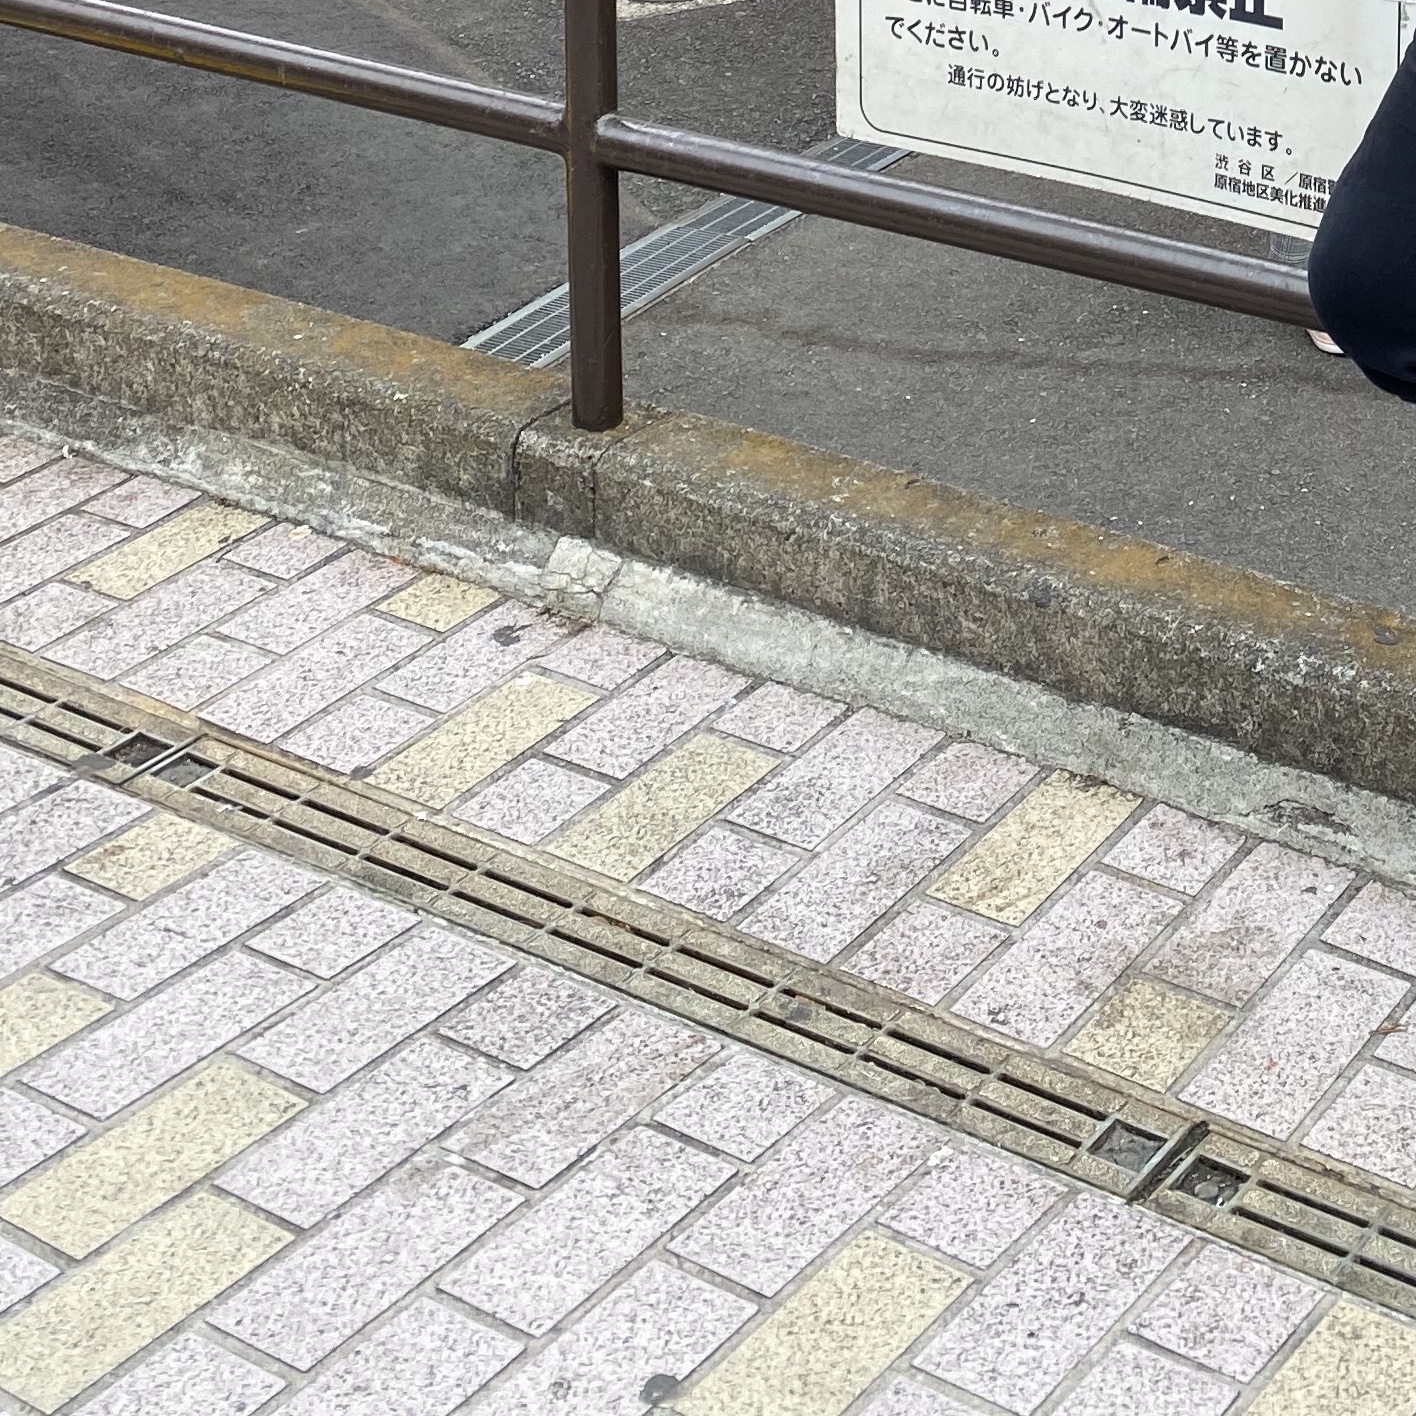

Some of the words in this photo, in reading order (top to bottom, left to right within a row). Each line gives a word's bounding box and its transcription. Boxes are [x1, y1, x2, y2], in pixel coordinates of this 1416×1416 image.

[885, 16, 999, 57] でください。
[948, 64, 1292, 156] 通行の妨げとなり、大変迷惑しています。
